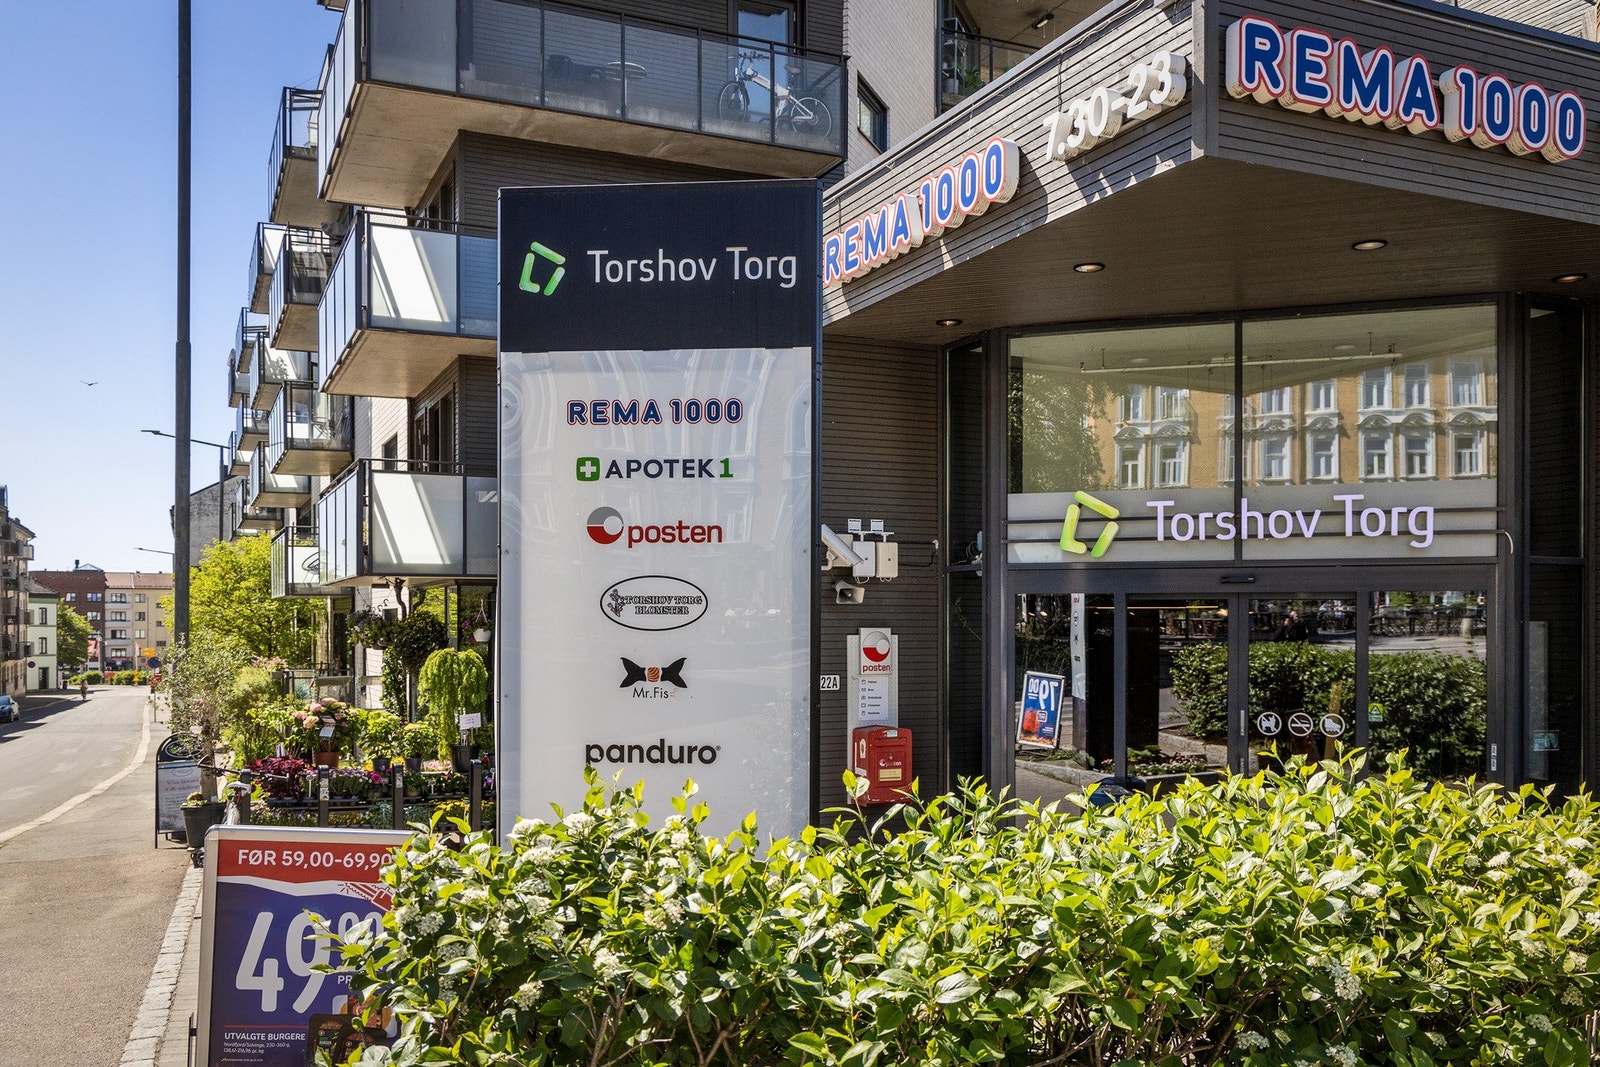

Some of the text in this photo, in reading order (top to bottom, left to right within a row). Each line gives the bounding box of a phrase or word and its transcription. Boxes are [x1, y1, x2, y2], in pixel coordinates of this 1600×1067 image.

[1236, 14, 1587, 160] REMA 1000
[1043, 51, 1184, 162] 7.30-23
[823, 136, 1010, 286] REMA 1000
[587, 246, 797, 289] Torshov Torg
[567, 397, 743, 426] REMA 1000
[627, 519, 723, 549] posten
[1146, 493, 1435, 549] Torshov Torg
[625, 595, 703, 605] TORSHOV TORG
[635, 605, 690, 615] BLOMSTER
[821, 676, 838, 689] 22A
[862, 664, 891, 673] posten
[633, 686, 675, 699] Mr.Fis
[238, 849, 393, 871] FØR 59,00-69,90
[235, 911, 332, 1014] 49
[224, 1032, 306, 1041] UTVALGTE BURGERE
